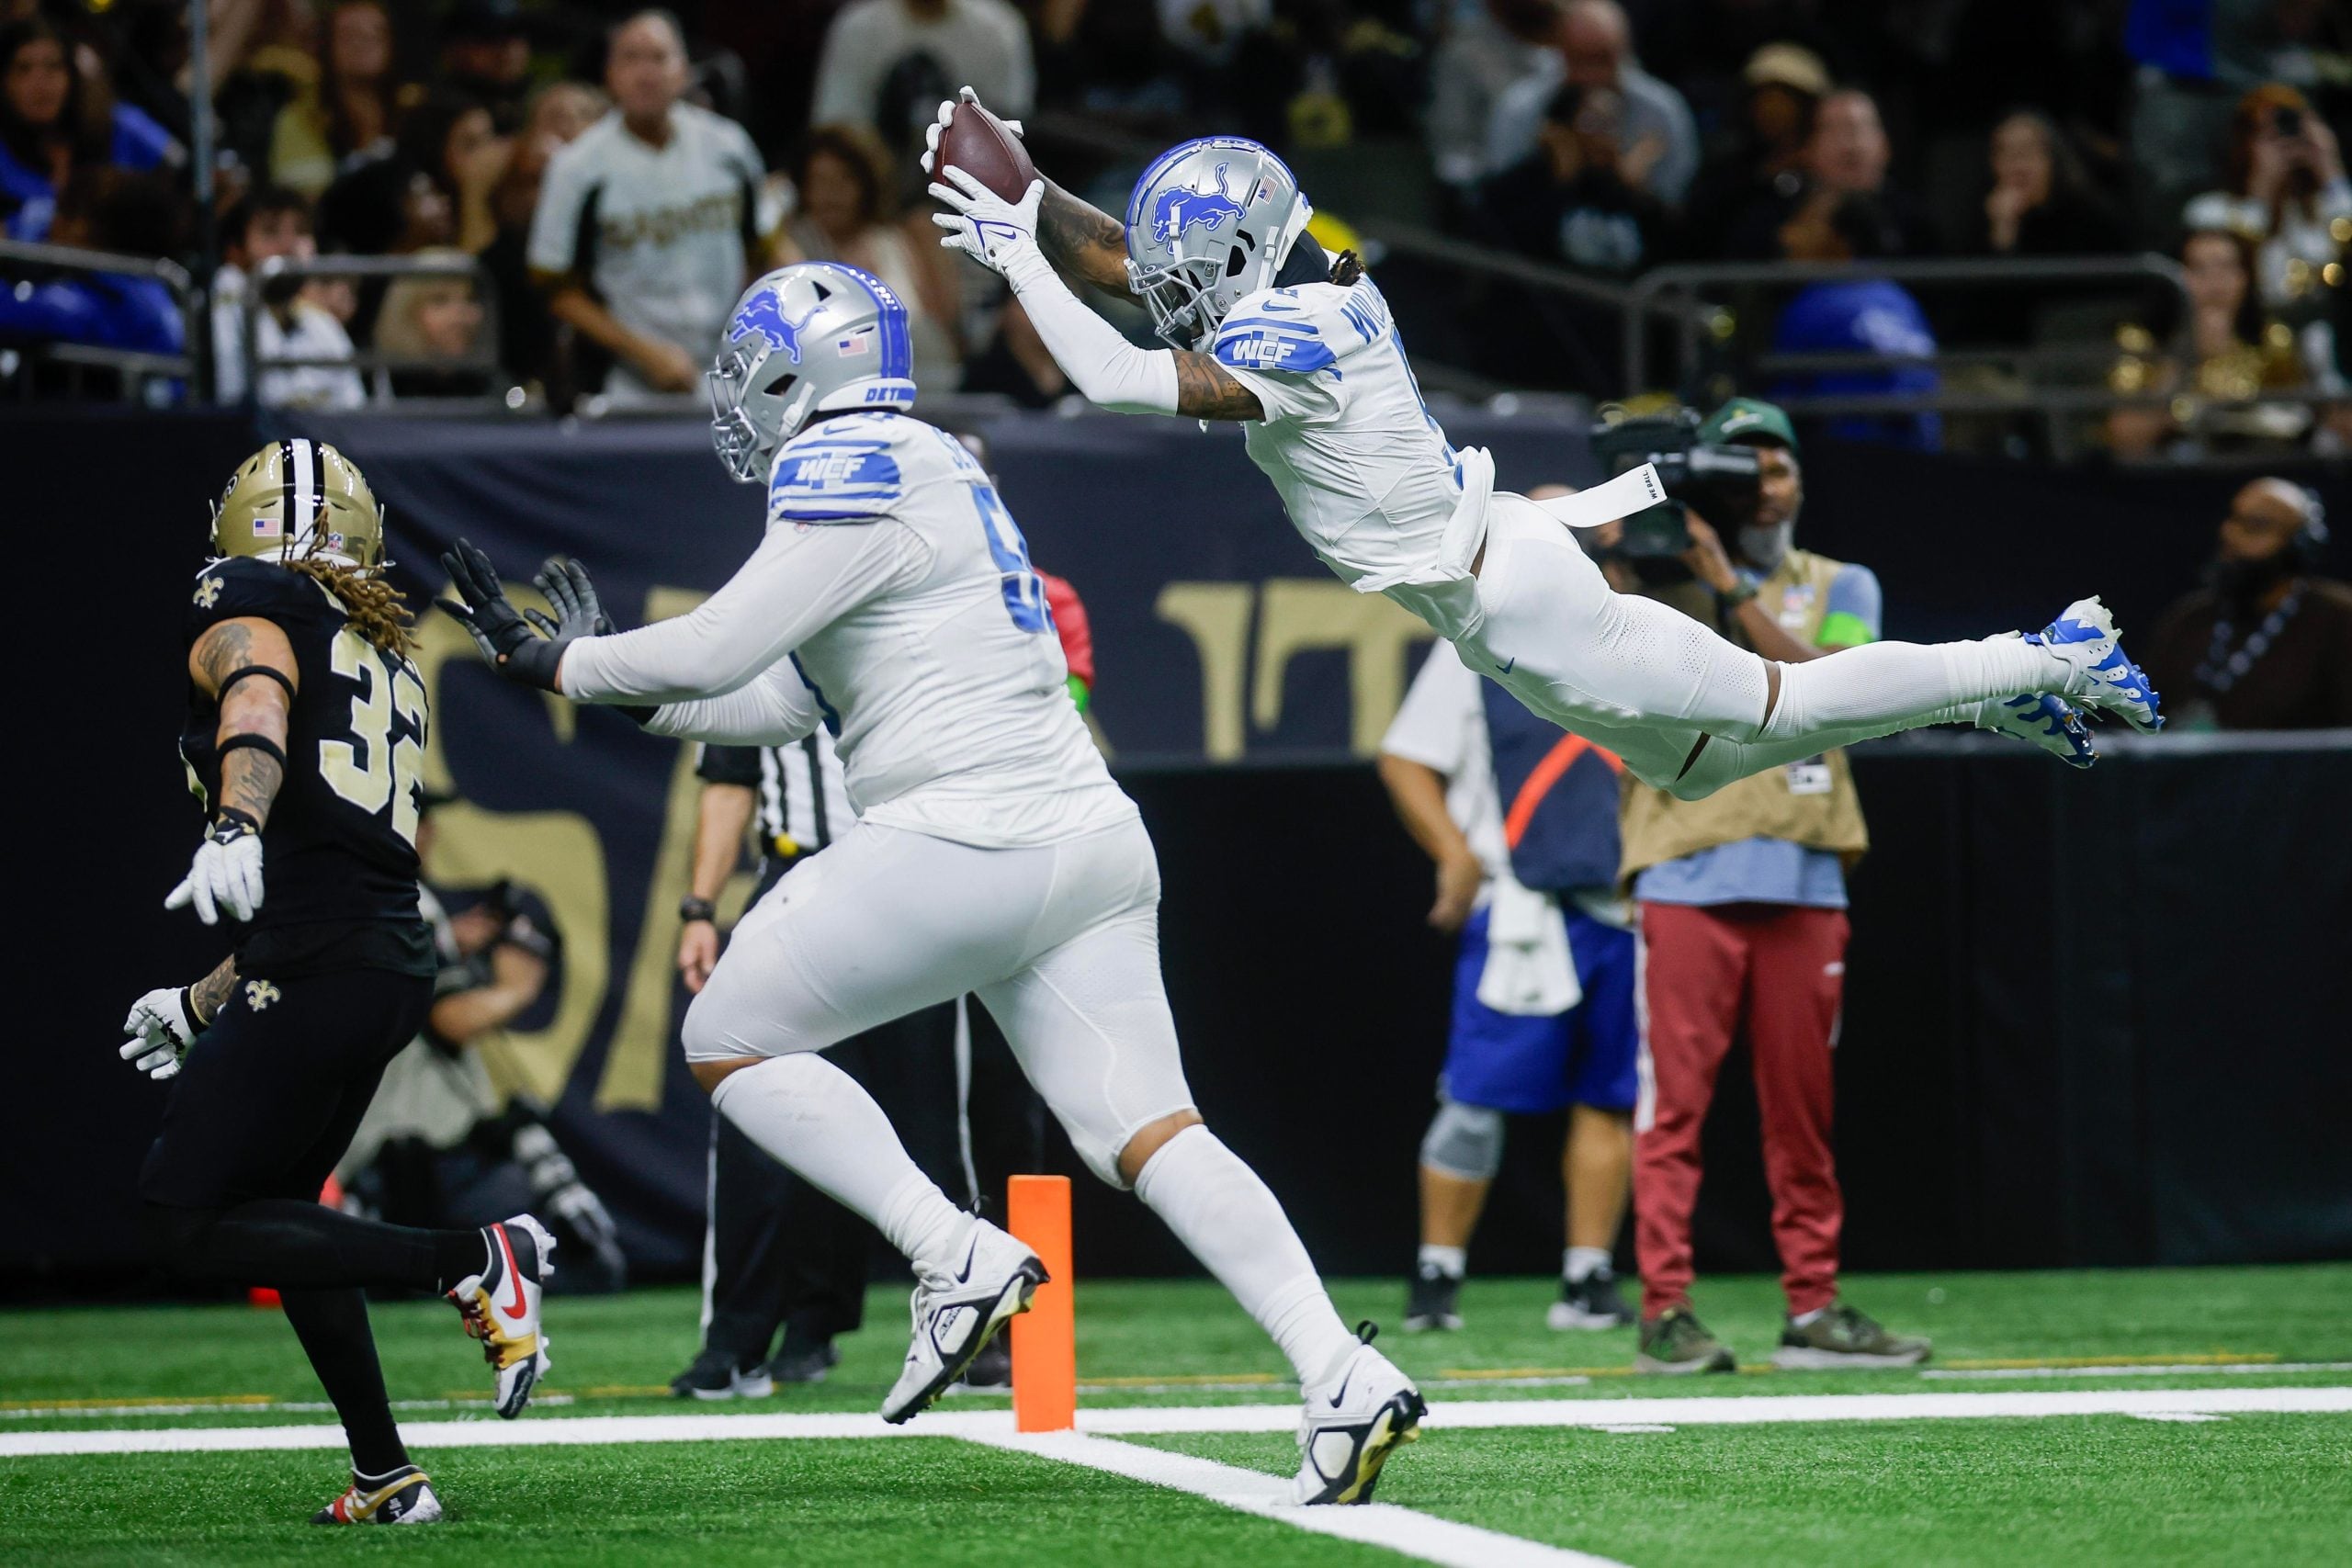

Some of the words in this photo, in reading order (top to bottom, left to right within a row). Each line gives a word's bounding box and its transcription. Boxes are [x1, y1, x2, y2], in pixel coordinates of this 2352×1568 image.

[1232, 339, 1296, 363] WCF
[795, 457, 865, 480] WCF
[1648, 488, 1658, 500] WE
[319, 629, 429, 850] 32
